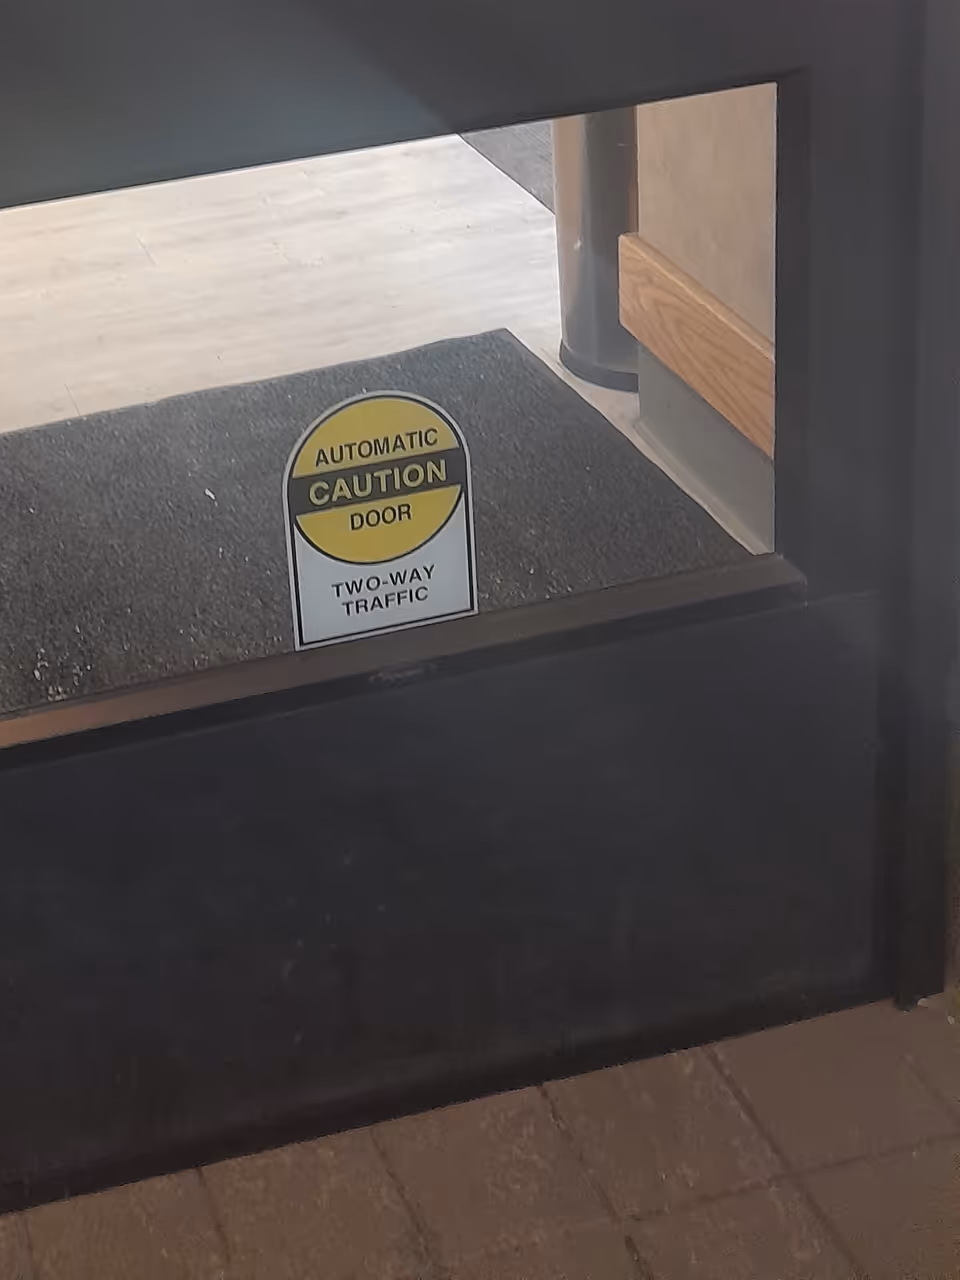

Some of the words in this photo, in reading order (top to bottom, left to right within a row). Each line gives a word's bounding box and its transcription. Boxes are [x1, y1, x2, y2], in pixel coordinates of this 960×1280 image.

[315, 428, 438, 467] AUTOMATIC
[309, 459, 447, 506] CAUTION
[350, 503, 412, 531] DOOR
[332, 564, 435, 598] TWO-WAY
[342, 586, 429, 616] TRAFFIC
